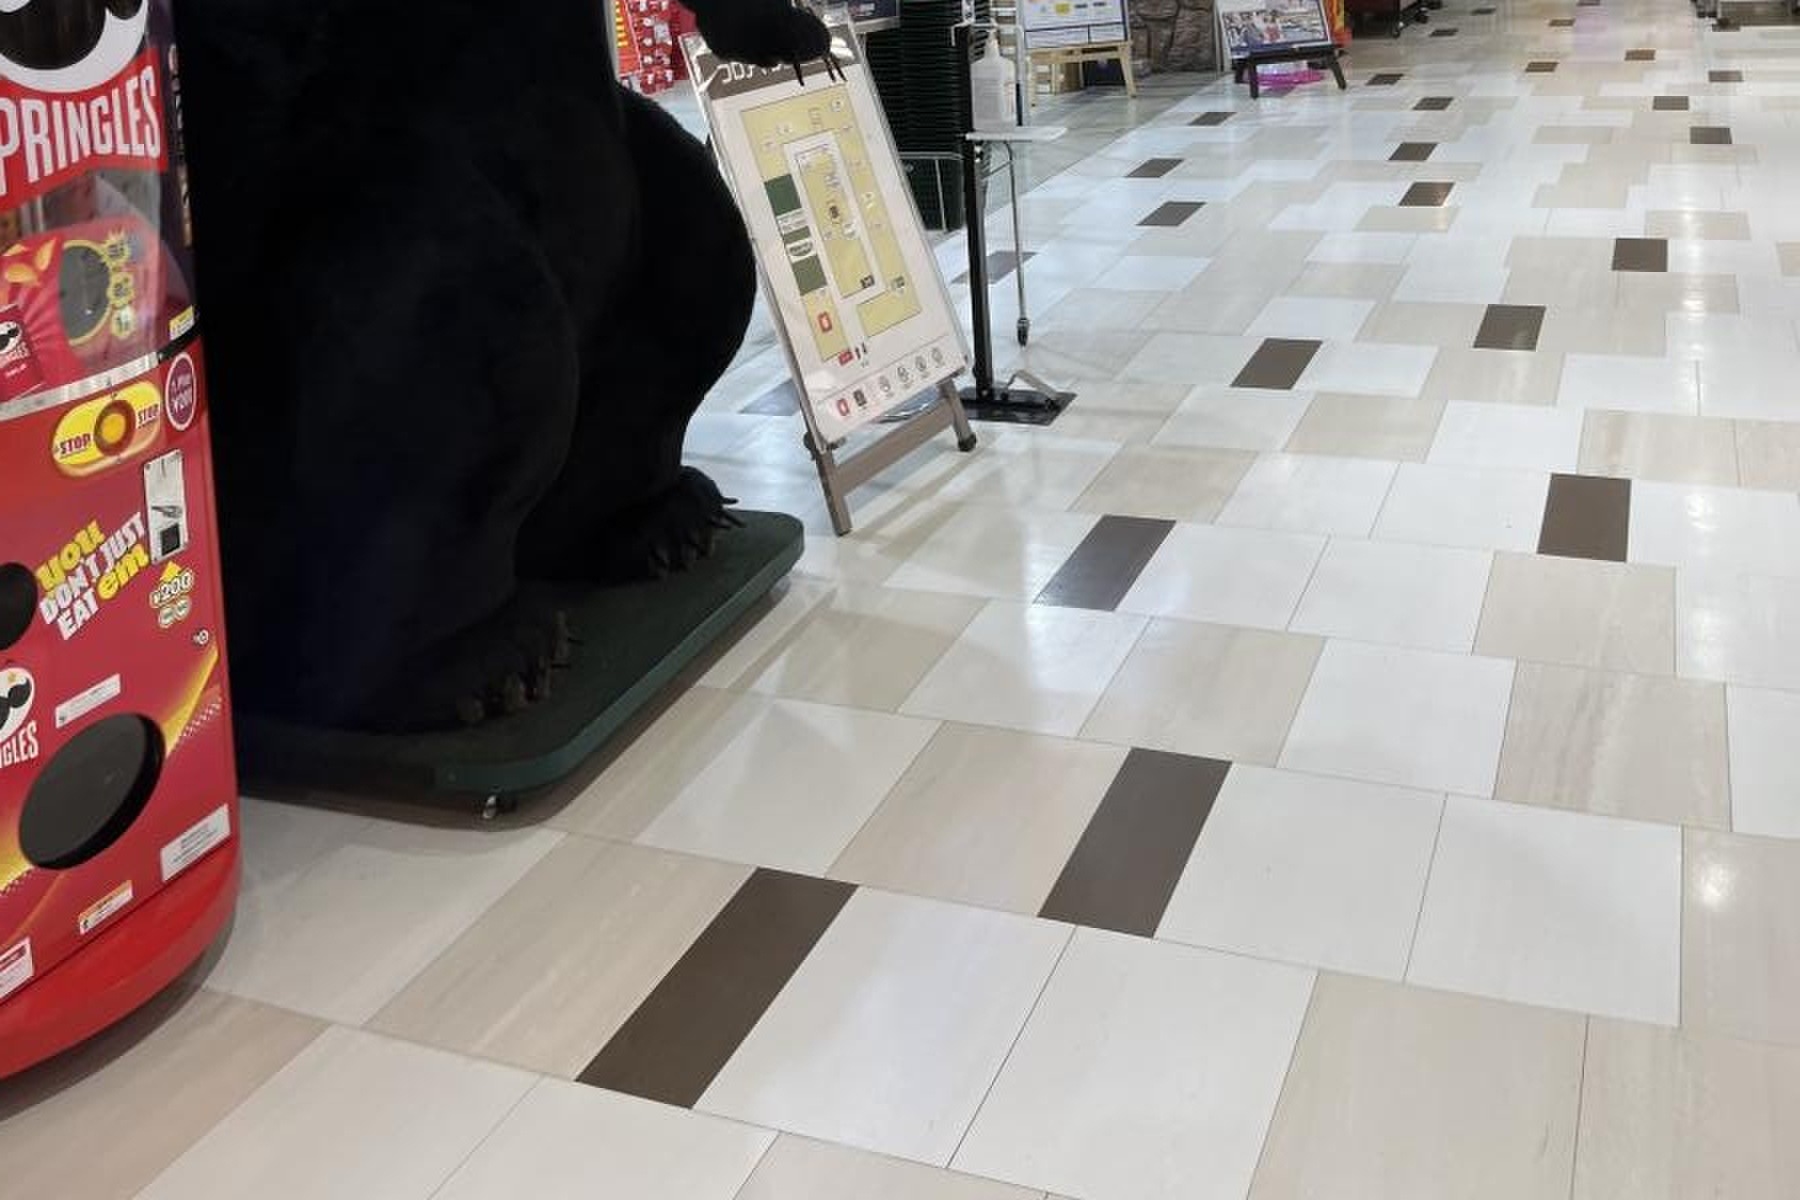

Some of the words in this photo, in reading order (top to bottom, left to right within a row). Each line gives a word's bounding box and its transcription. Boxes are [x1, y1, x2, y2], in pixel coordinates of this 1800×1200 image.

[0, 65, 161, 197] PRINGLES
[59, 432, 92, 456] STOP
[99, 511, 145, 576] JUST
[57, 587, 99, 641] EAT
